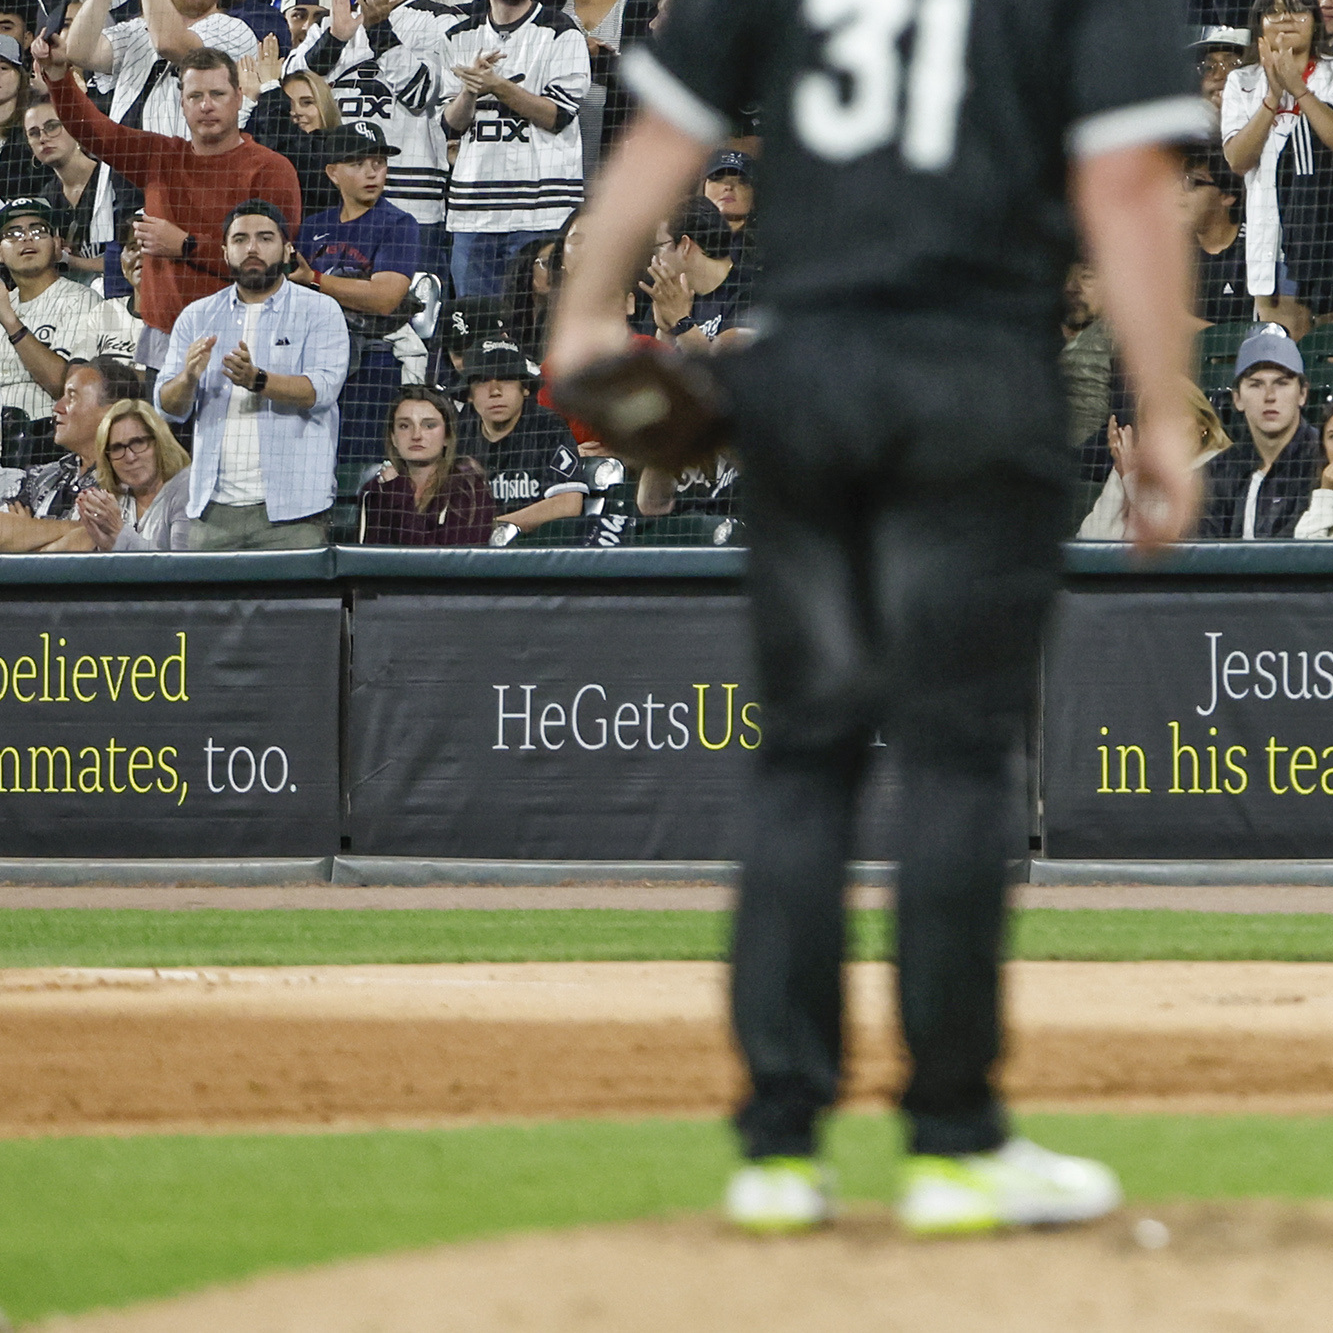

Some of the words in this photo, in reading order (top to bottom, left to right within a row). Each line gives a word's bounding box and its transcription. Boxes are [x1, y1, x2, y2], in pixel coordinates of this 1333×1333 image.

[0, 632, 189, 703] elieved
[205, 737, 299, 795] too.
[1097, 726, 1151, 794] in
[1168, 721, 1249, 795] his
